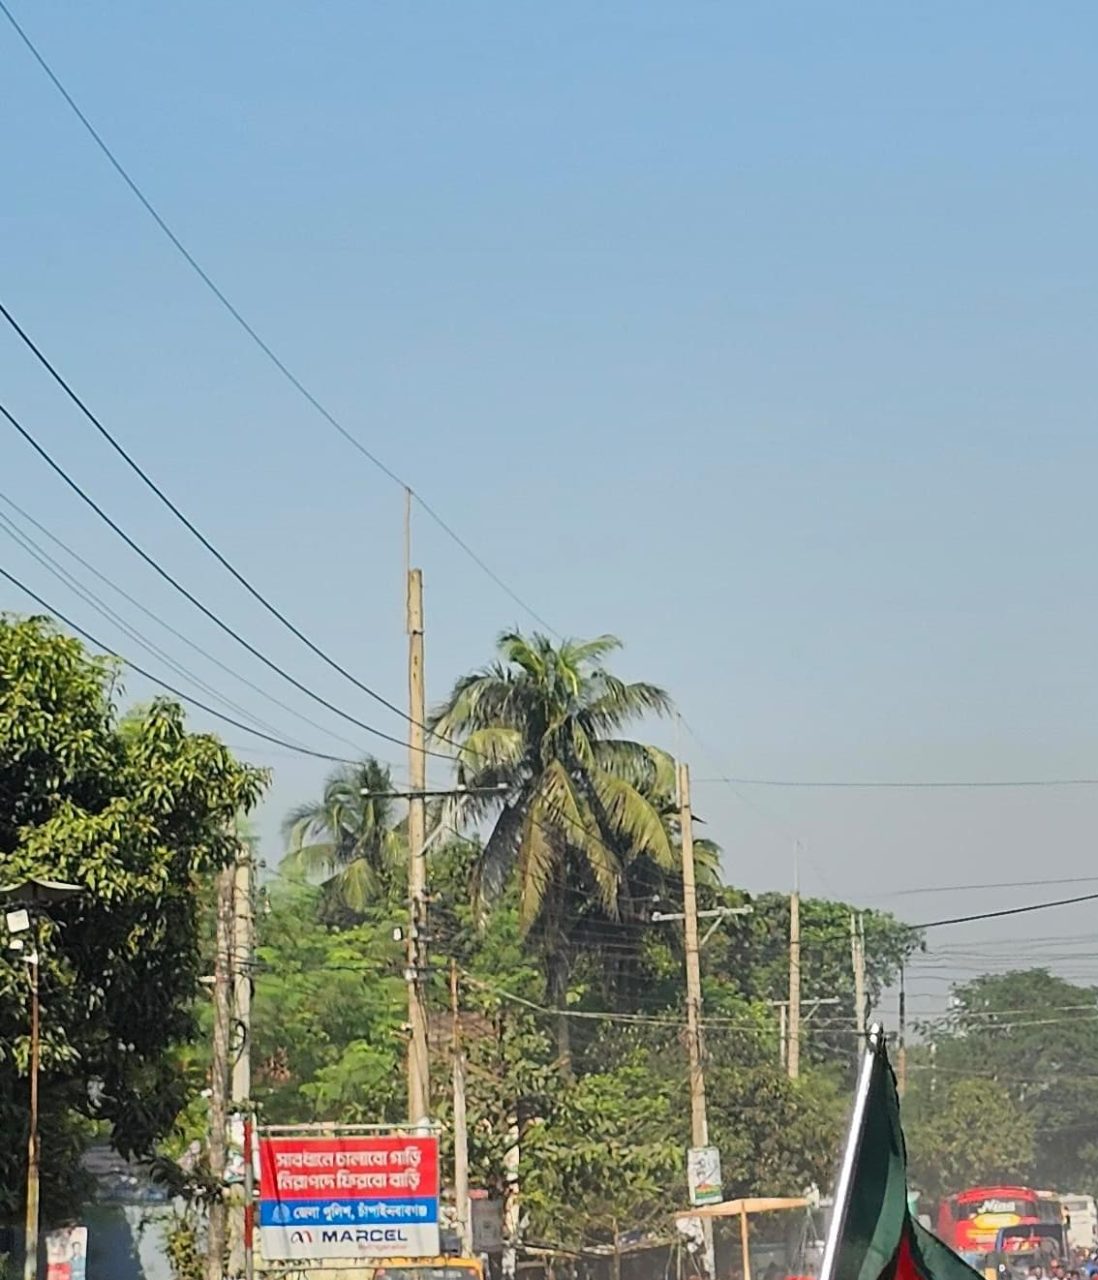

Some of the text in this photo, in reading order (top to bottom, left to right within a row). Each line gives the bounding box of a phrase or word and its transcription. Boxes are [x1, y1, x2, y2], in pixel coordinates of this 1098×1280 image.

[276, 1146, 421, 1168] সাবধানে চালাবো গাড়ি
[277, 1168, 421, 1190] নিরাপদে ফিরবো বাড়ি
[322, 1229, 408, 1243] MARCEL
